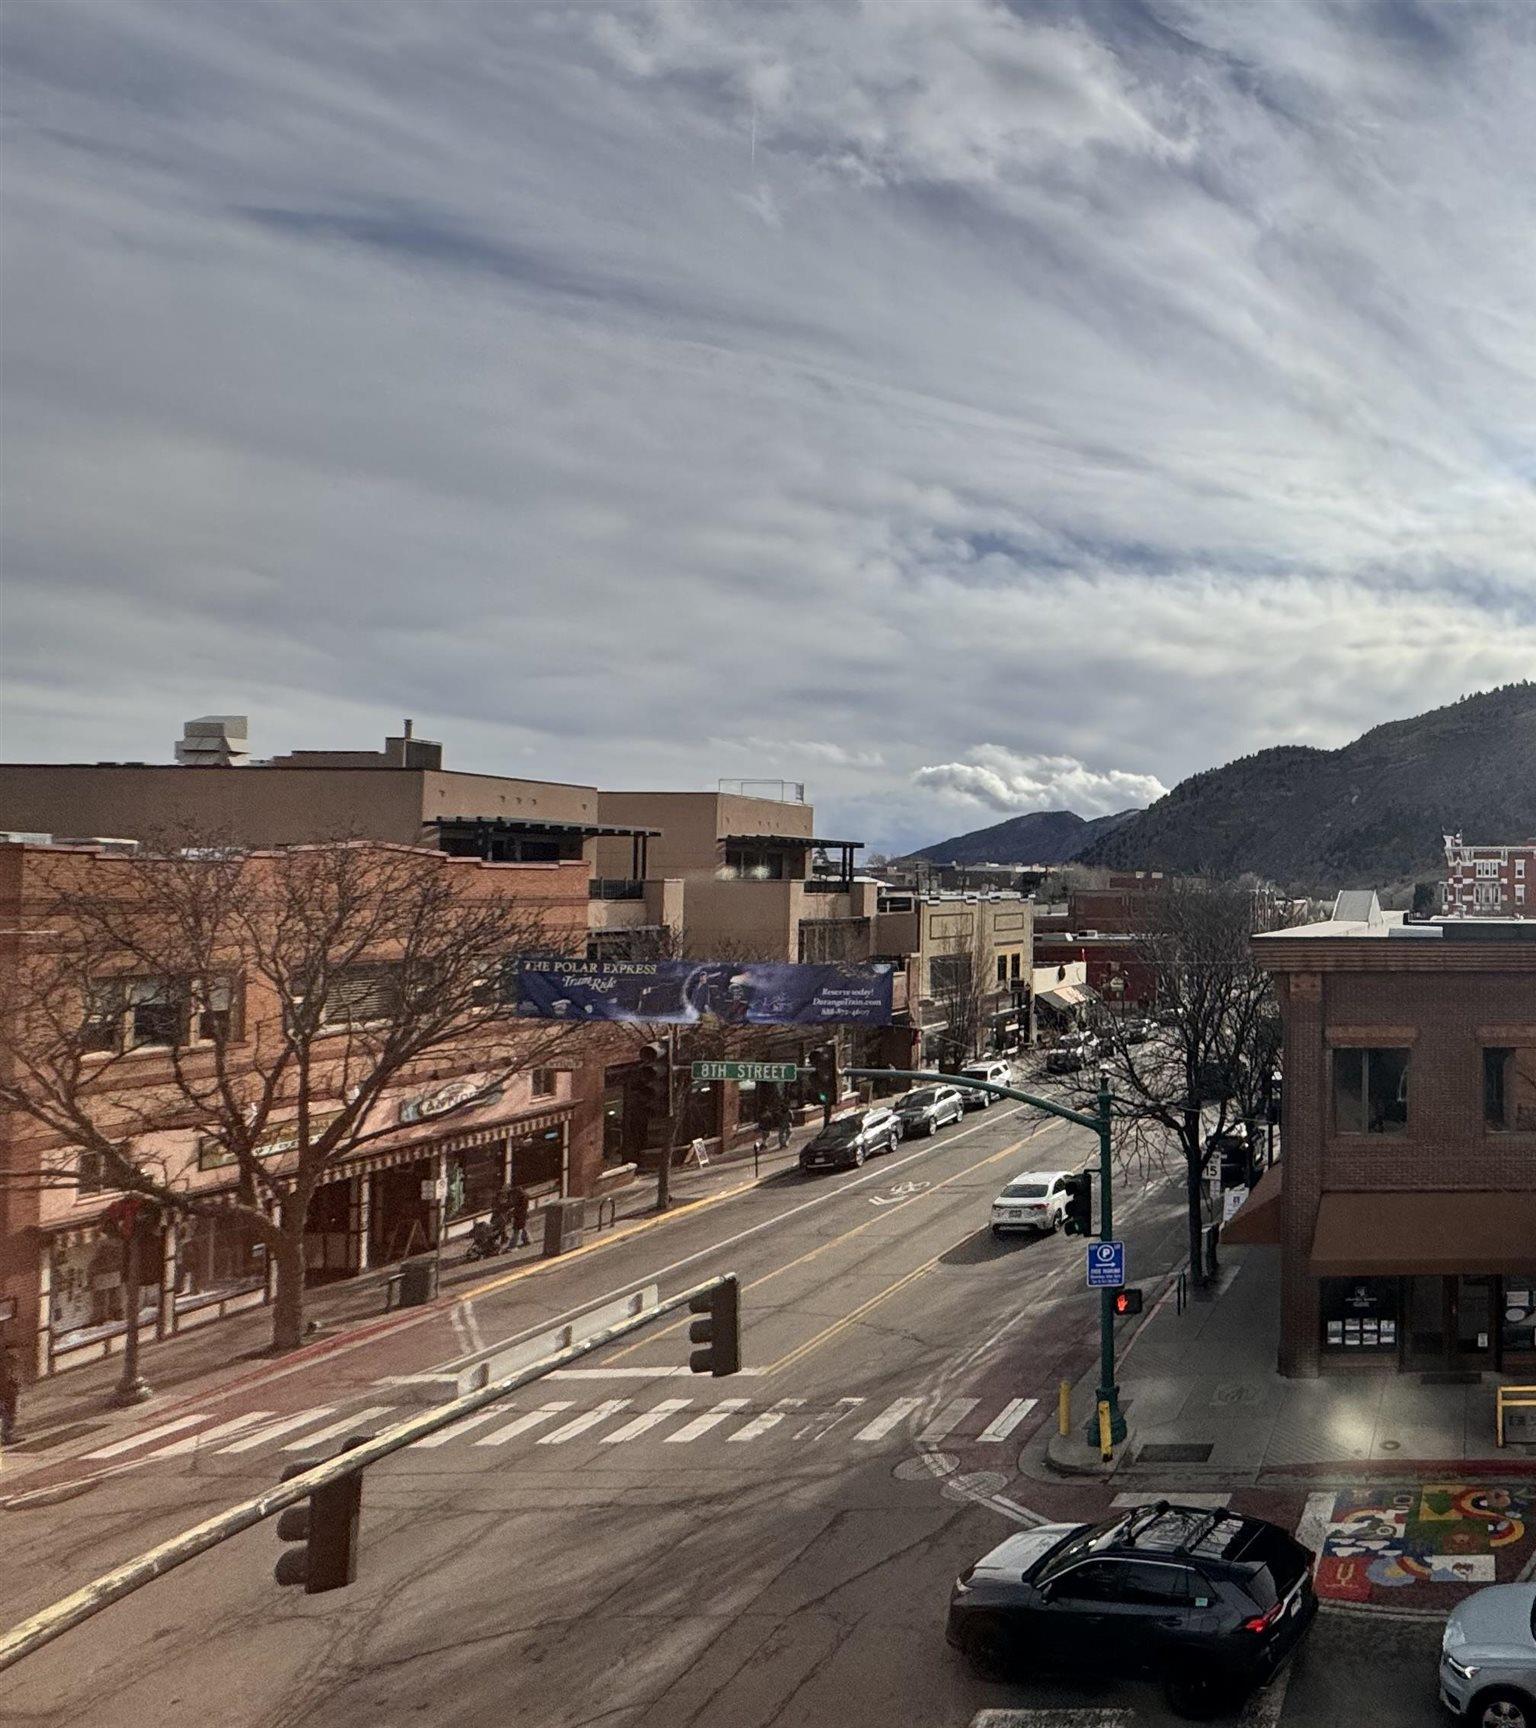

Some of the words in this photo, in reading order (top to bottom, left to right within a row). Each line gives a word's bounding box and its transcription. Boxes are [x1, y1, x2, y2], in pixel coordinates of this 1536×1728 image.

[524, 961, 551, 972] THE
[554, 961, 598, 973] POLAR
[602, 962, 657, 974] EXPRESS
[588, 977, 617, 993] Ride
[822, 988, 851, 996] Reserve
[812, 997, 882, 1007] DurangoTrain.com
[701, 1064, 727, 1078] 8TH
[737, 1064, 786, 1079] STREET
